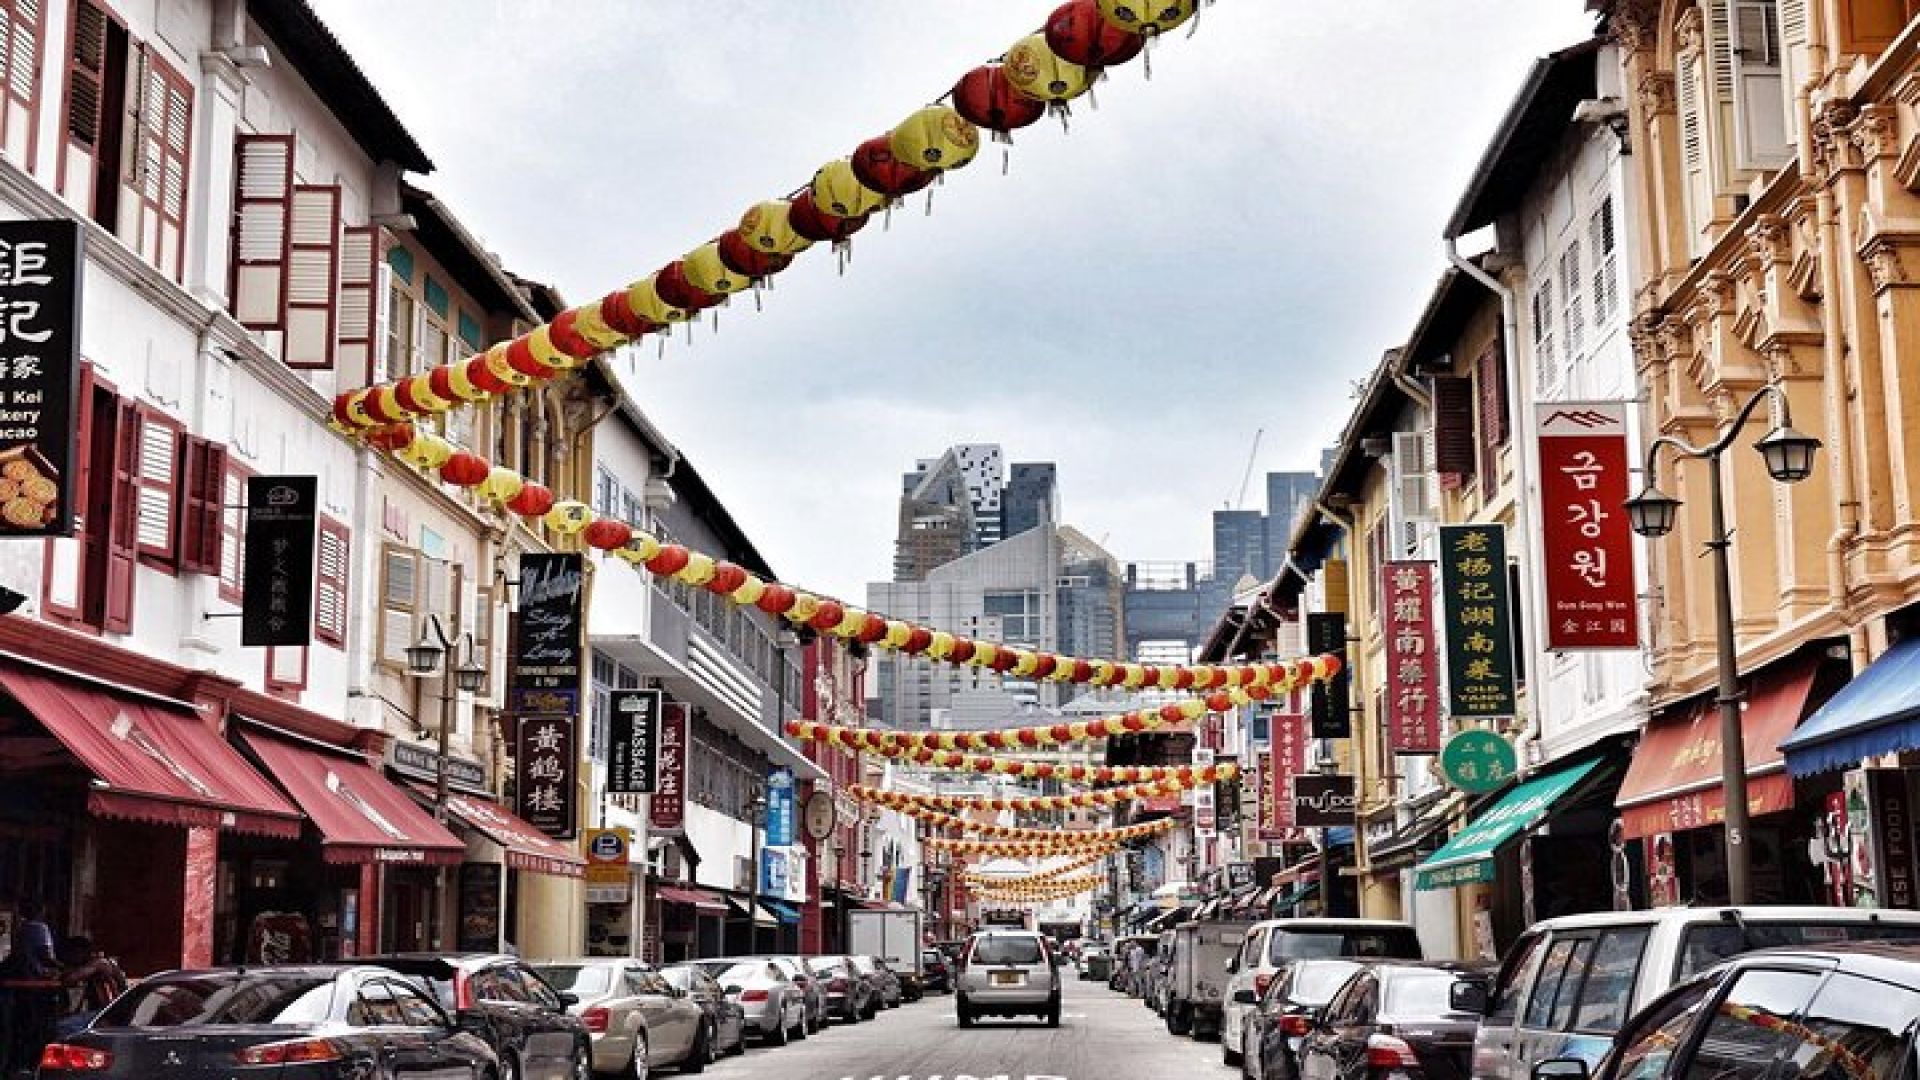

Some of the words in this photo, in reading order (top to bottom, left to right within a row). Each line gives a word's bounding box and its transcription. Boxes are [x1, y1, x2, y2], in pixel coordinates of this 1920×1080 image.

[13, 390, 43, 404] Kei
[1559, 451, 1609, 589] 금강원
[629, 713, 648, 791] MASSAGE
[1886, 797, 1904, 855] FOOD
